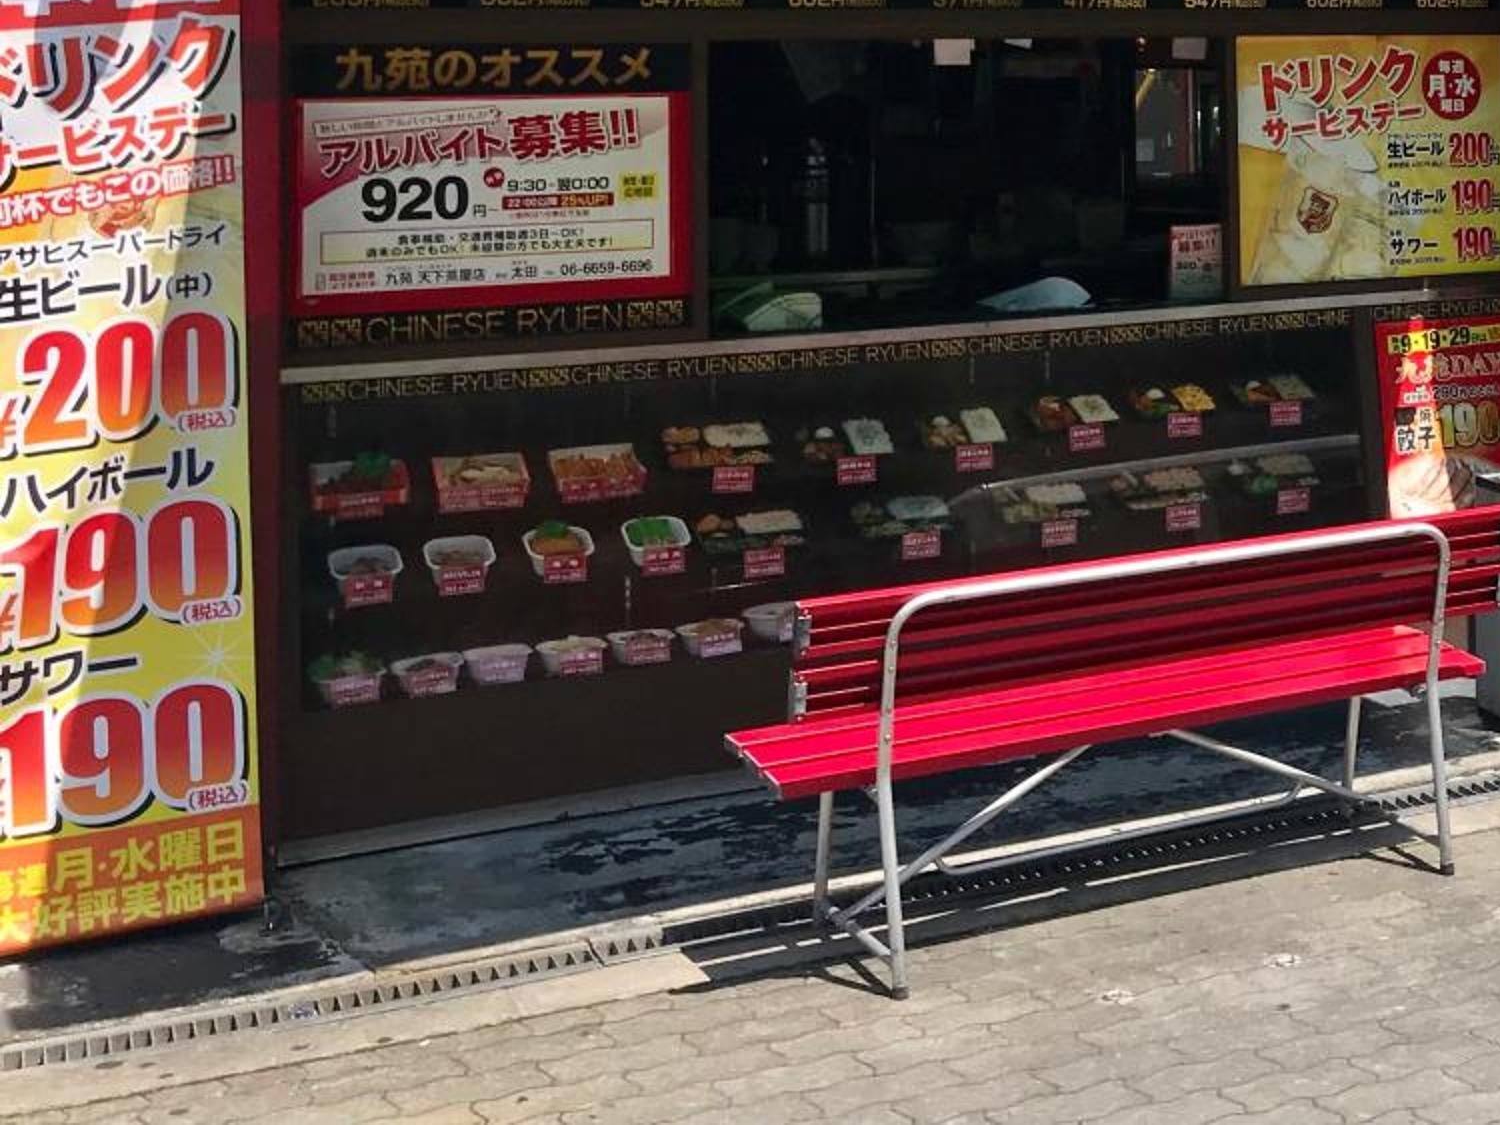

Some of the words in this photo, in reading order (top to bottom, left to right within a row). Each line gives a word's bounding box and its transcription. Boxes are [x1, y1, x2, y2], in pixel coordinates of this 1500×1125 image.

[335, 47, 654, 92] 九苑のオススメ
[1258, 44, 1419, 113] ドリンク
[0, 103, 237, 180] ービスデー
[321, 107, 641, 176] アルバイト募集!!
[1261, 101, 1424, 147] サービスデー
[1387, 140, 1445, 158] 生ビール
[1388, 188, 1447, 206] ハイボール
[1390, 237, 1439, 255] サワー
[366, 309, 507, 346] CHINESE
[517, 304, 625, 335] RYUEN
[347, 378, 445, 401] CHINESE
[453, 371, 529, 394] RYUEN
[571, 361, 658, 387] CHINESE
[666, 355, 738, 378] RYUEN
[777, 346, 860, 372] CHINESE
[865, 339, 930, 363] RYUEN
[968, 333, 1046, 357] CHINESE
[1050, 326, 1109, 350] RYUEN
[1143, 320, 1216, 343] CHINESE
[1219, 315, 1275, 336] RYUEN
[0, 445, 216, 518] ハイボール
[0, 653, 140, 707] サワー
[0, 683, 240, 840] 190
